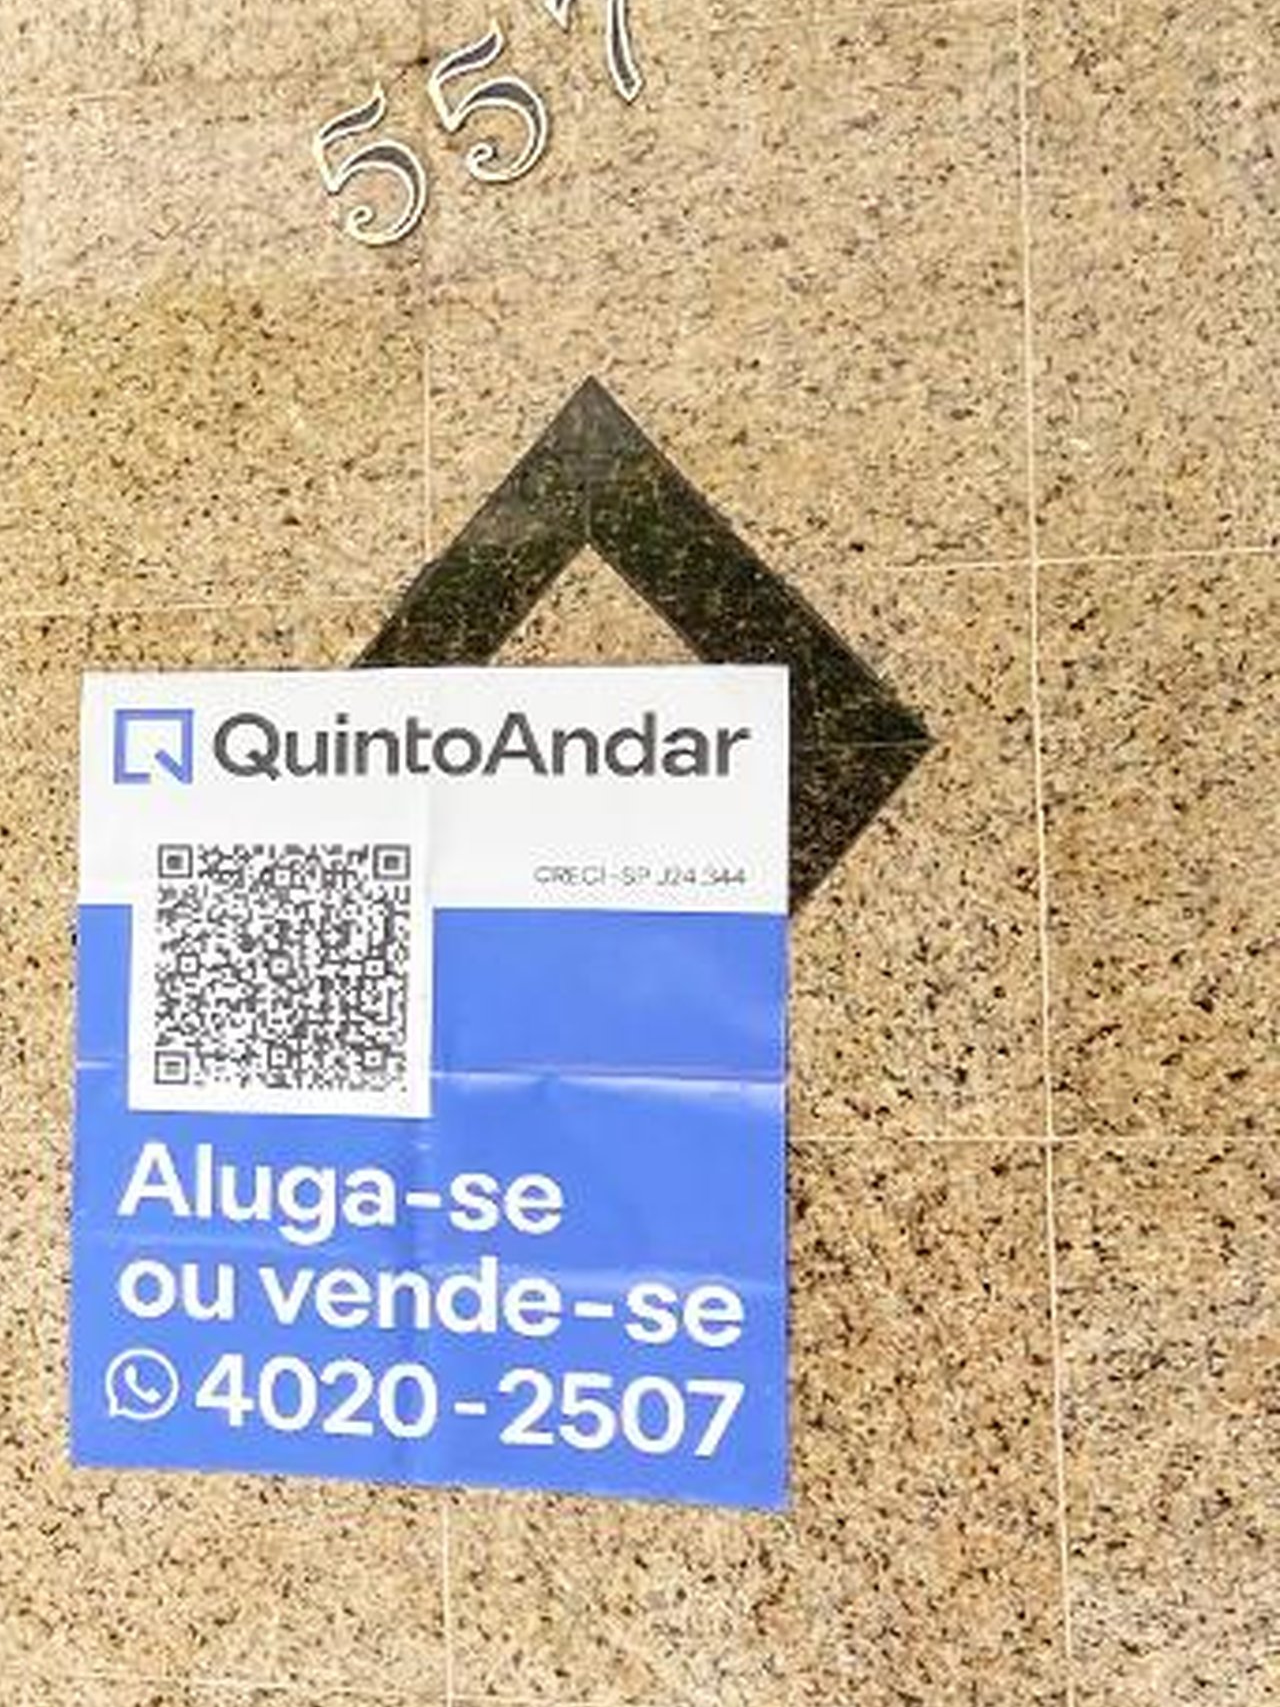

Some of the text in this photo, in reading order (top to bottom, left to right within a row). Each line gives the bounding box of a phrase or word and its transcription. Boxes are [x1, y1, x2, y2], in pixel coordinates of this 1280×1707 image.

[212, 710, 752, 782] QuintoAndar
[117, 1143, 564, 1246] Aluga-se
[117, 1256, 745, 1349] ou vende-se
